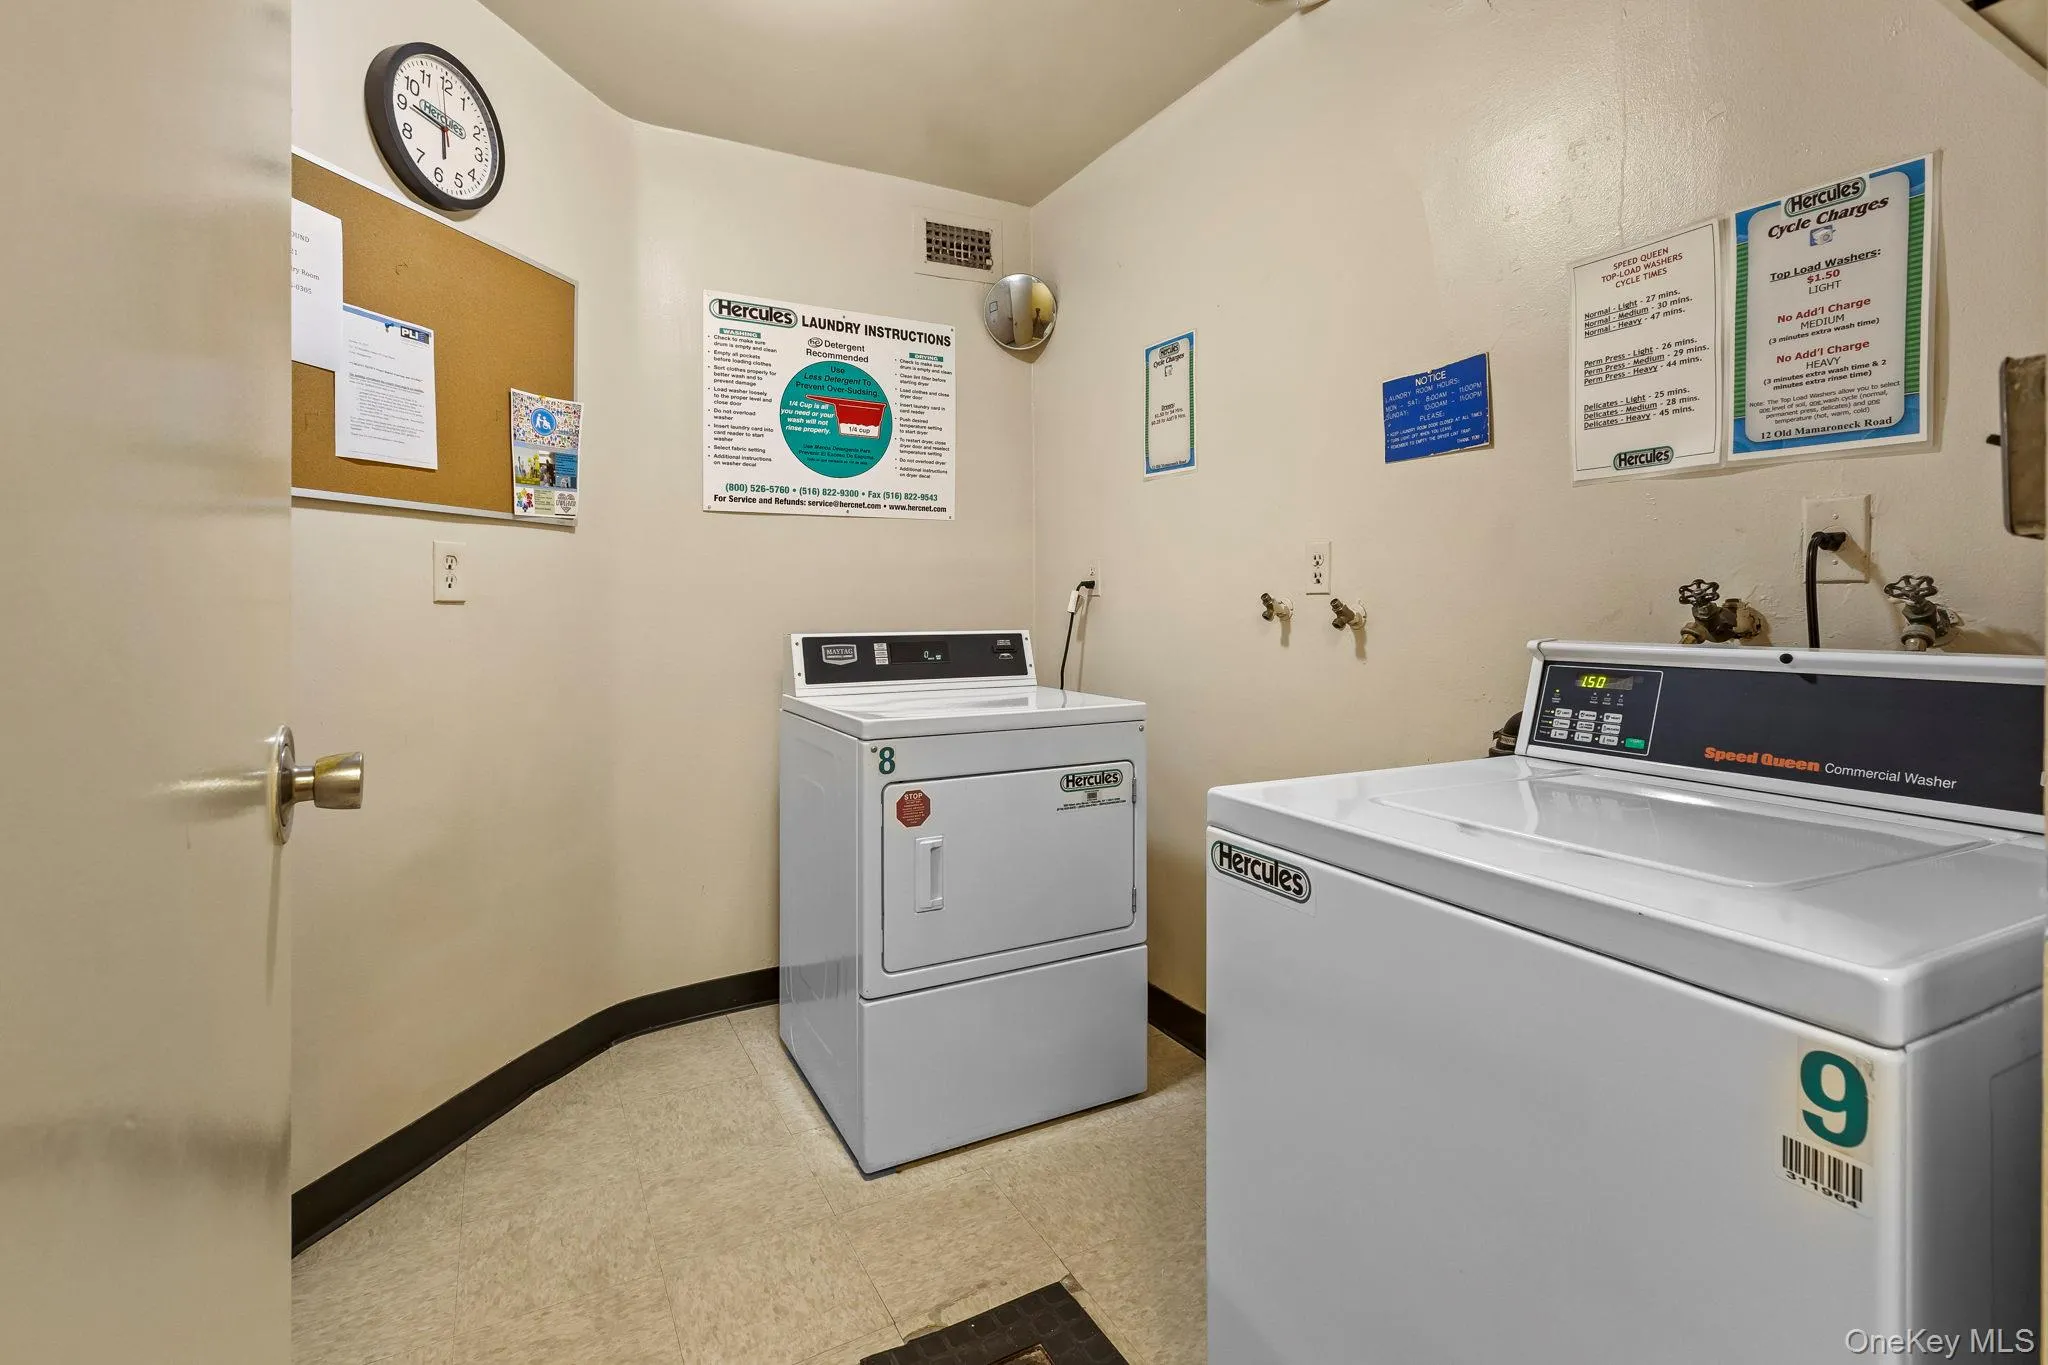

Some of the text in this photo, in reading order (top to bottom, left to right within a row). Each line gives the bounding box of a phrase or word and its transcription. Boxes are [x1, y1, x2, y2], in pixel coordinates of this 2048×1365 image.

[404, 75, 420, 96] 10
[420, 69, 431, 88] 11
[440, 75, 453, 96] 12
[397, 93, 407, 110] 9
[460, 97, 465, 111] 1
[423, 102, 464, 137] Hercules
[402, 123, 413, 140] 8
[472, 125, 481, 141] 2
[416, 147, 426, 163] 7
[474, 147, 483, 163] 3
[433, 167, 444, 183] 6
[454, 172, 463, 189] 5
[467, 168, 475, 182] 4
[1790, 180, 1860, 213] Hercules
[1767, 196, 1889, 239] Cycle Charges
[1600, 252, 1683, 282] TOP-LOAD WASHERS
[1612, 246, 1668, 270] SPEED QUEEN
[1769, 248, 1880, 281] Top Load Washers:
[1615, 266, 1667, 288] CYCLE TIMES
[1806, 268, 1840, 284] $1.50
[1808, 279, 1842, 294] LIGHT
[717, 299, 793, 325] Hercules
[1584, 289, 1680, 319] Normal Light 27 mins.
[1584, 295, 1692, 328] Normal Medium 30 mins.
[1777, 298, 1871, 323] No Add'l Charge
[801, 314, 951, 347] LAUNDRY INSTRUCTIONS
[1584, 307, 1685, 337] Normal Heavy 47 mins.
[1768, 317, 1879, 345] (3 minutes extra wash time)
[1800, 313, 1844, 330] MEDIUM
[805, 347, 868, 363] Recommended
[824, 339, 864, 352] Detergent
[1583, 337, 1697, 367] Perm Press Light 26 mins.
[1776, 340, 1869, 363] No Add'l Charge
[1583, 344, 1709, 376] Perm Press Medium 29 mins.
[1583, 356, 1702, 384] Perm Press Heavy 44 mins.
[1805, 355, 1840, 369] HEAVY
[823, 374, 861, 385] Detergent
[861, 378, 871, 386] To
[1415, 370, 1446, 386] NOTICE
[1763, 378, 1771, 386] (3
[1772, 373, 1803, 383] minutes
[1804, 370, 1826, 378] extra
[1827, 365, 1849, 374] wash
[1850, 362, 1869, 370] time
[1772, 381, 1803, 390] minutes
[1804, 377, 1825, 385] extra
[1849, 369, 1872, 378] time)
[795, 380, 824, 390] Prevent
[798, 401, 812, 409] Cup
[1583, 387, 1690, 411] Delicates Light 25 mins.
[1583, 395, 1699, 420] Delicates Medium 28 mins.
[1583, 406, 1694, 428] Delicates Heavy 45 mins.
[1761, 416, 1892, 439] 12 Old Mamaroneck Road
[1618, 447, 1670, 468] Hercules
[725, 482, 937, 501] (800) 526-5760 (516) 822-9300 Fax (516) 822-9543
[713, 493, 946, 512] For Service and Refunds: service@hercnet.com www.hercnet.com
[878, 746, 896, 775] 8
[1704, 746, 1958, 790] Speed Queen Commercial Washer
[1065, 771, 1119, 788] Hercules
[904, 792, 923, 800] STOP
[1219, 842, 1304, 896] Hercules
[1800, 1050, 1869, 1149] 9
[1785, 1170, 1859, 1210] 311964
